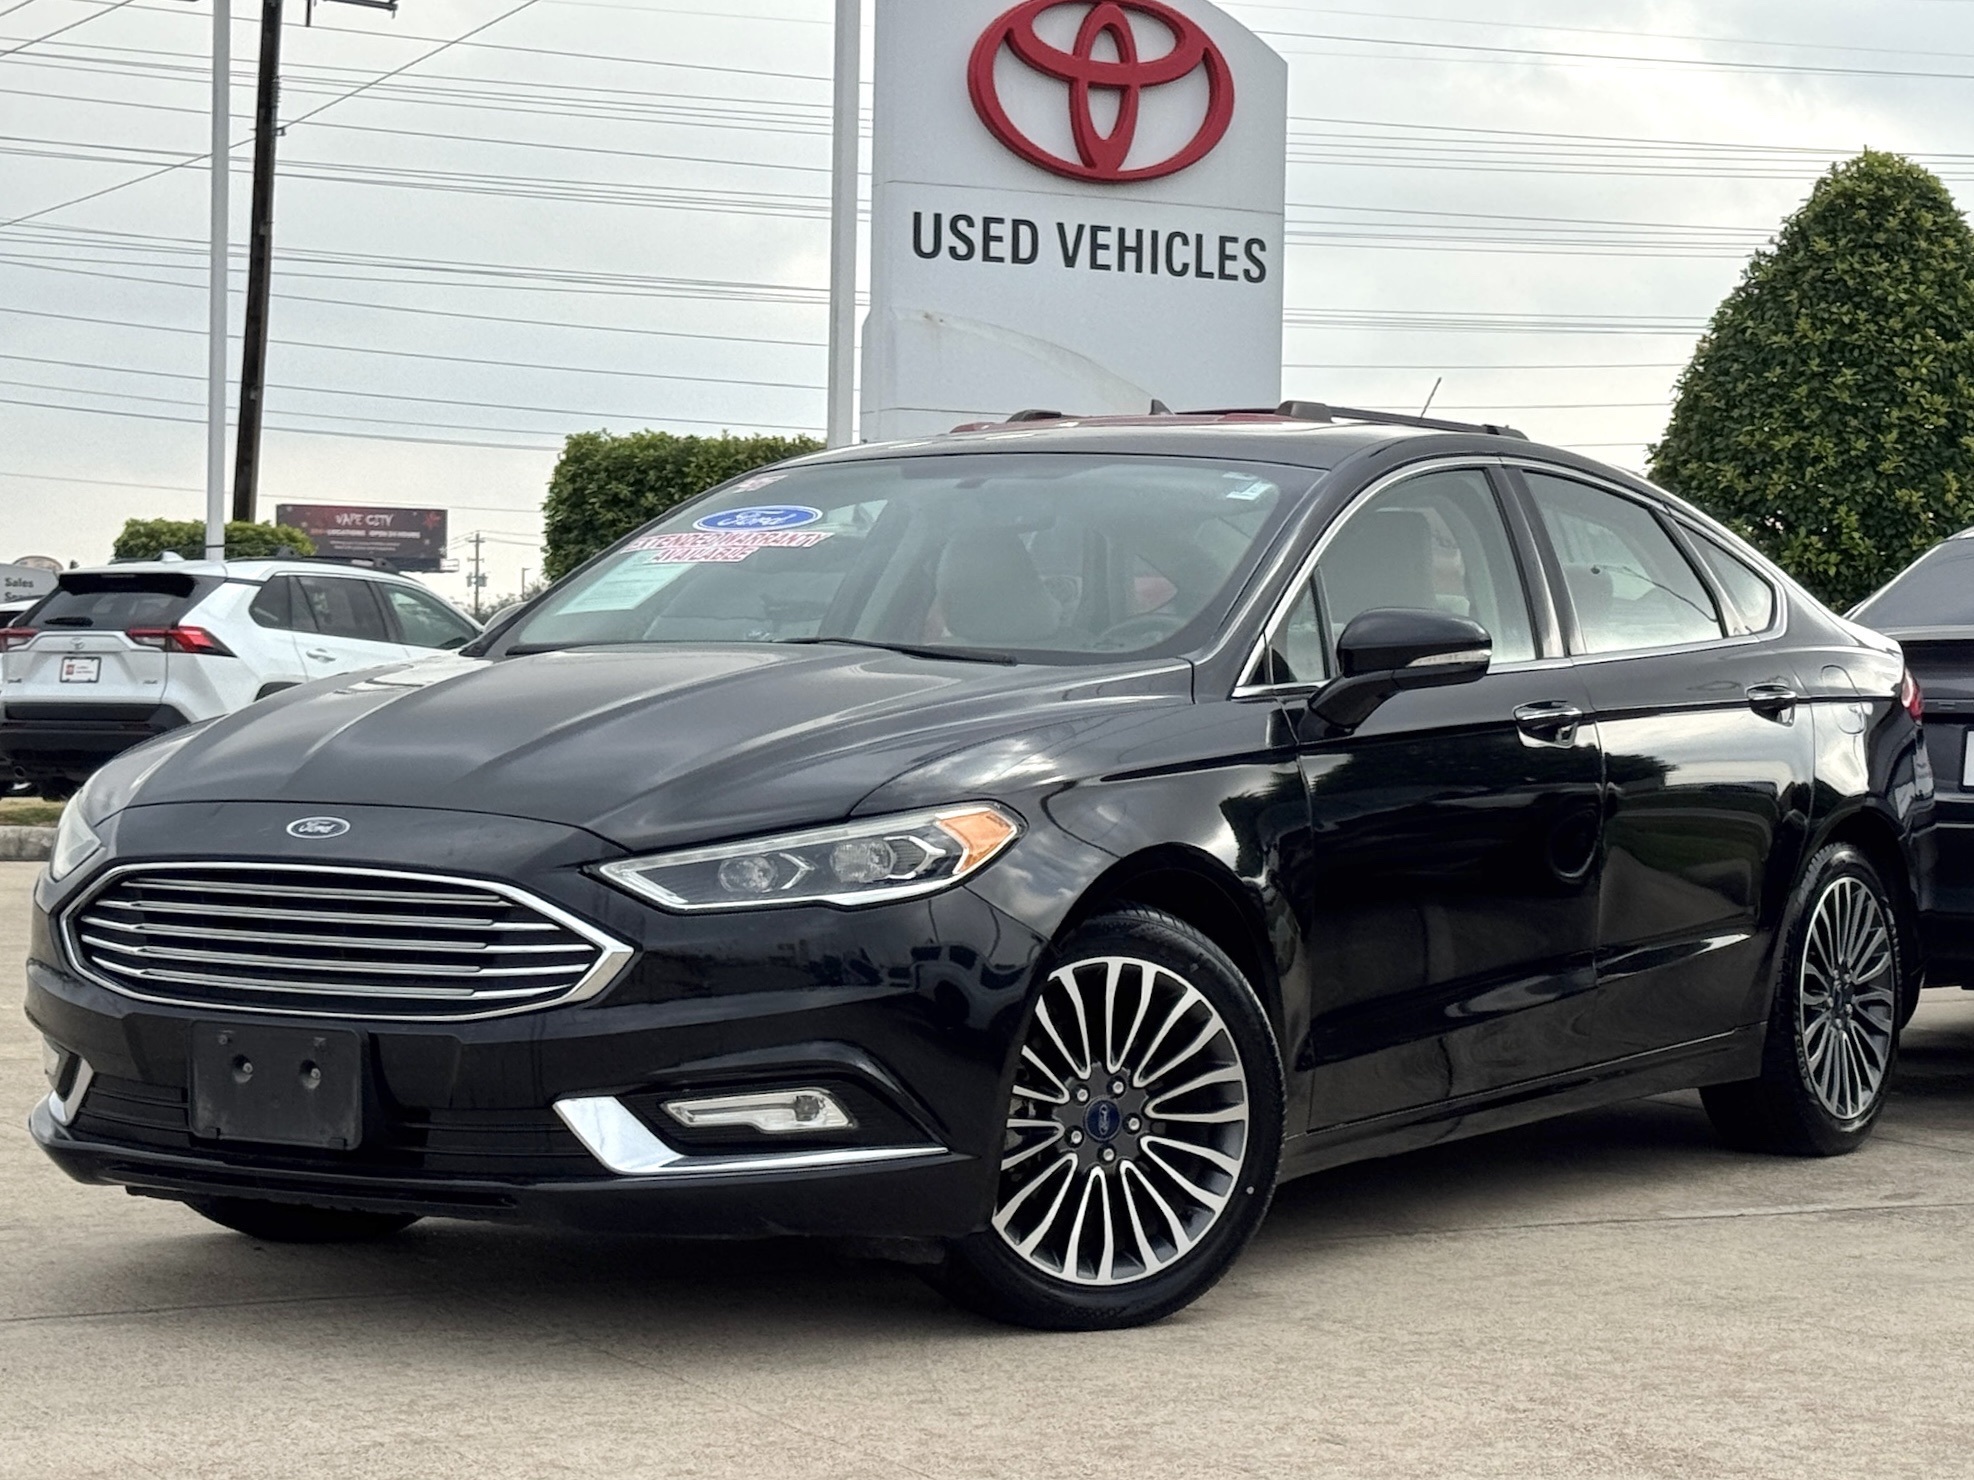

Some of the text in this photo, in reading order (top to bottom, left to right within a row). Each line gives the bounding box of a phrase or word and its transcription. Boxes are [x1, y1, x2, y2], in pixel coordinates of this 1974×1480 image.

[912, 211, 1268, 284] USED VEHICLES
[335, 512, 394, 527] VAPE CITY
[718, 531, 833, 548] WARRANTY
[652, 547, 757, 562] AVAILABLE
[5, 577, 34, 588] Sales
